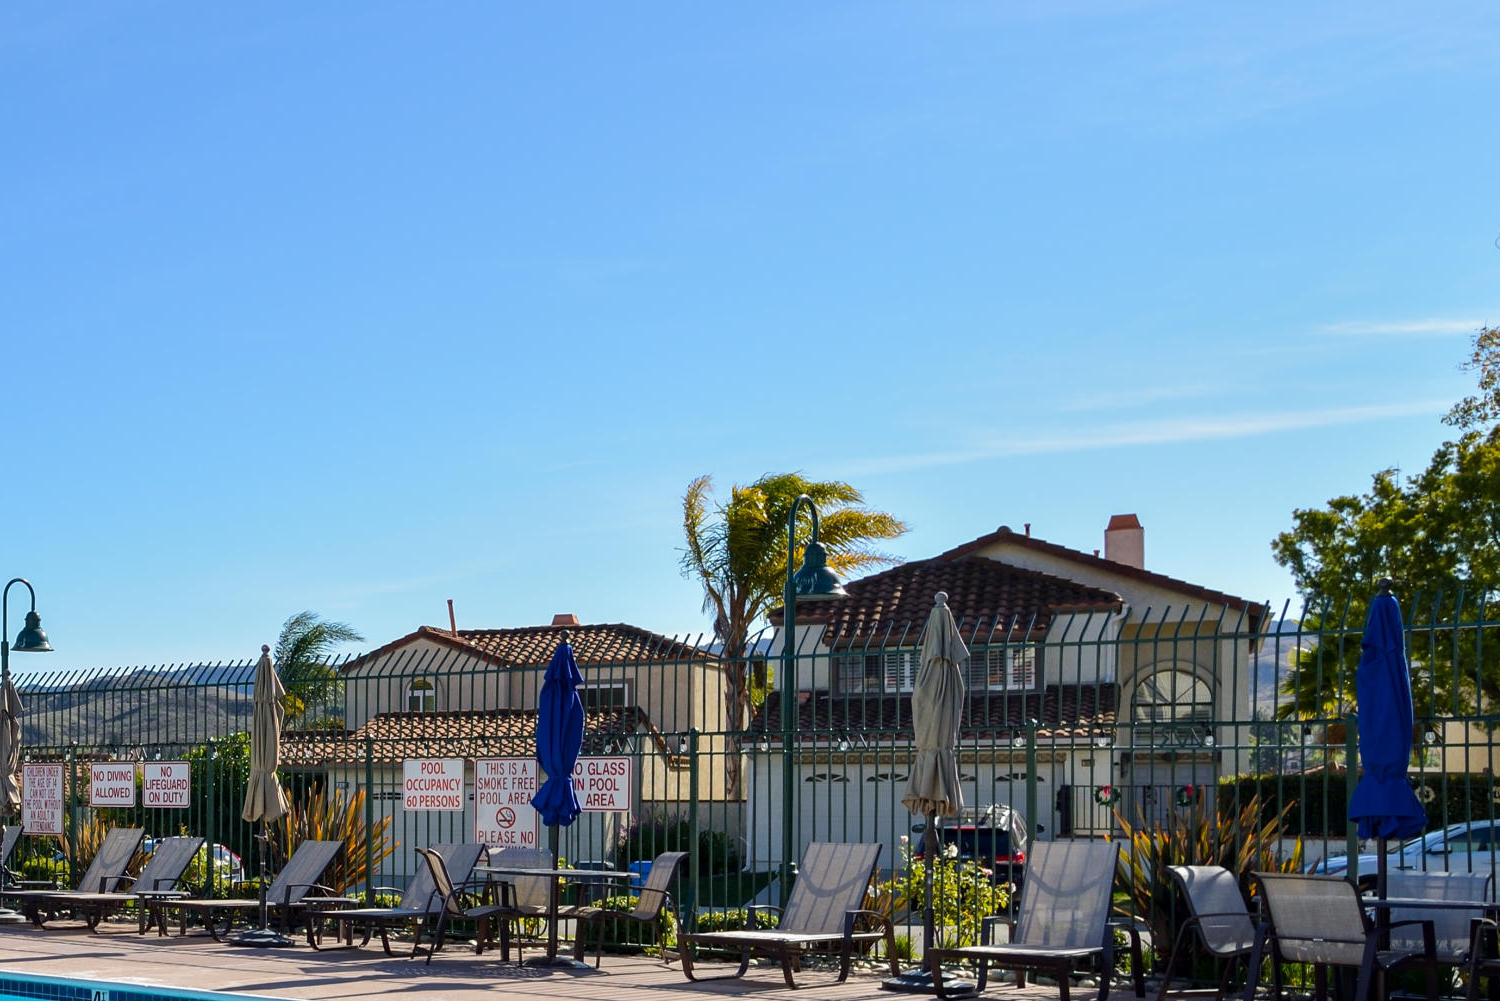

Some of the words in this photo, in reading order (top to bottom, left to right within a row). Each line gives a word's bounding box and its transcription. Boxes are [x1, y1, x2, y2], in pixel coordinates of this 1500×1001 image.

[27, 767, 45, 777] CHILDREN
[46, 767, 59, 777] UNDER
[160, 766, 172, 777] NO
[421, 762, 445, 775] POOL
[485, 762, 505, 775] THIS
[508, 762, 517, 775] IS
[521, 763, 528, 775] A
[588, 762, 625, 775] GLASS
[93, 771, 104, 781] NO
[107, 771, 132, 782] DIVING
[37, 778, 45, 788] AGE
[46, 778, 51, 788] OF
[145, 779, 187, 790] LIFEGUARD
[406, 778, 460, 791] OCCUPANCY
[478, 777, 508, 790] SMOKE
[511, 777, 535, 790] FREE
[575, 778, 585, 791] IN
[590, 778, 620, 791] POOL
[30, 789, 38, 799] CAN
[48, 789, 56, 799] USE
[95, 787, 130, 798] ALLOWED
[149, 792, 160, 803] ON
[163, 792, 183, 803] DUTY
[32, 799, 43, 809] POOL
[45, 799, 61, 809] WITHOUT
[406, 795, 417, 807] 60
[420, 795, 460, 807] PERSONS
[480, 792, 503, 805] POOL
[508, 792, 532, 805] AREA
[586, 793, 615, 806] AREA
[37, 810, 49, 820] ADULT
[30, 821, 55, 831] ATTENDANCE
[478, 830, 516, 843] PLEASE
[520, 831, 534, 844] NO
